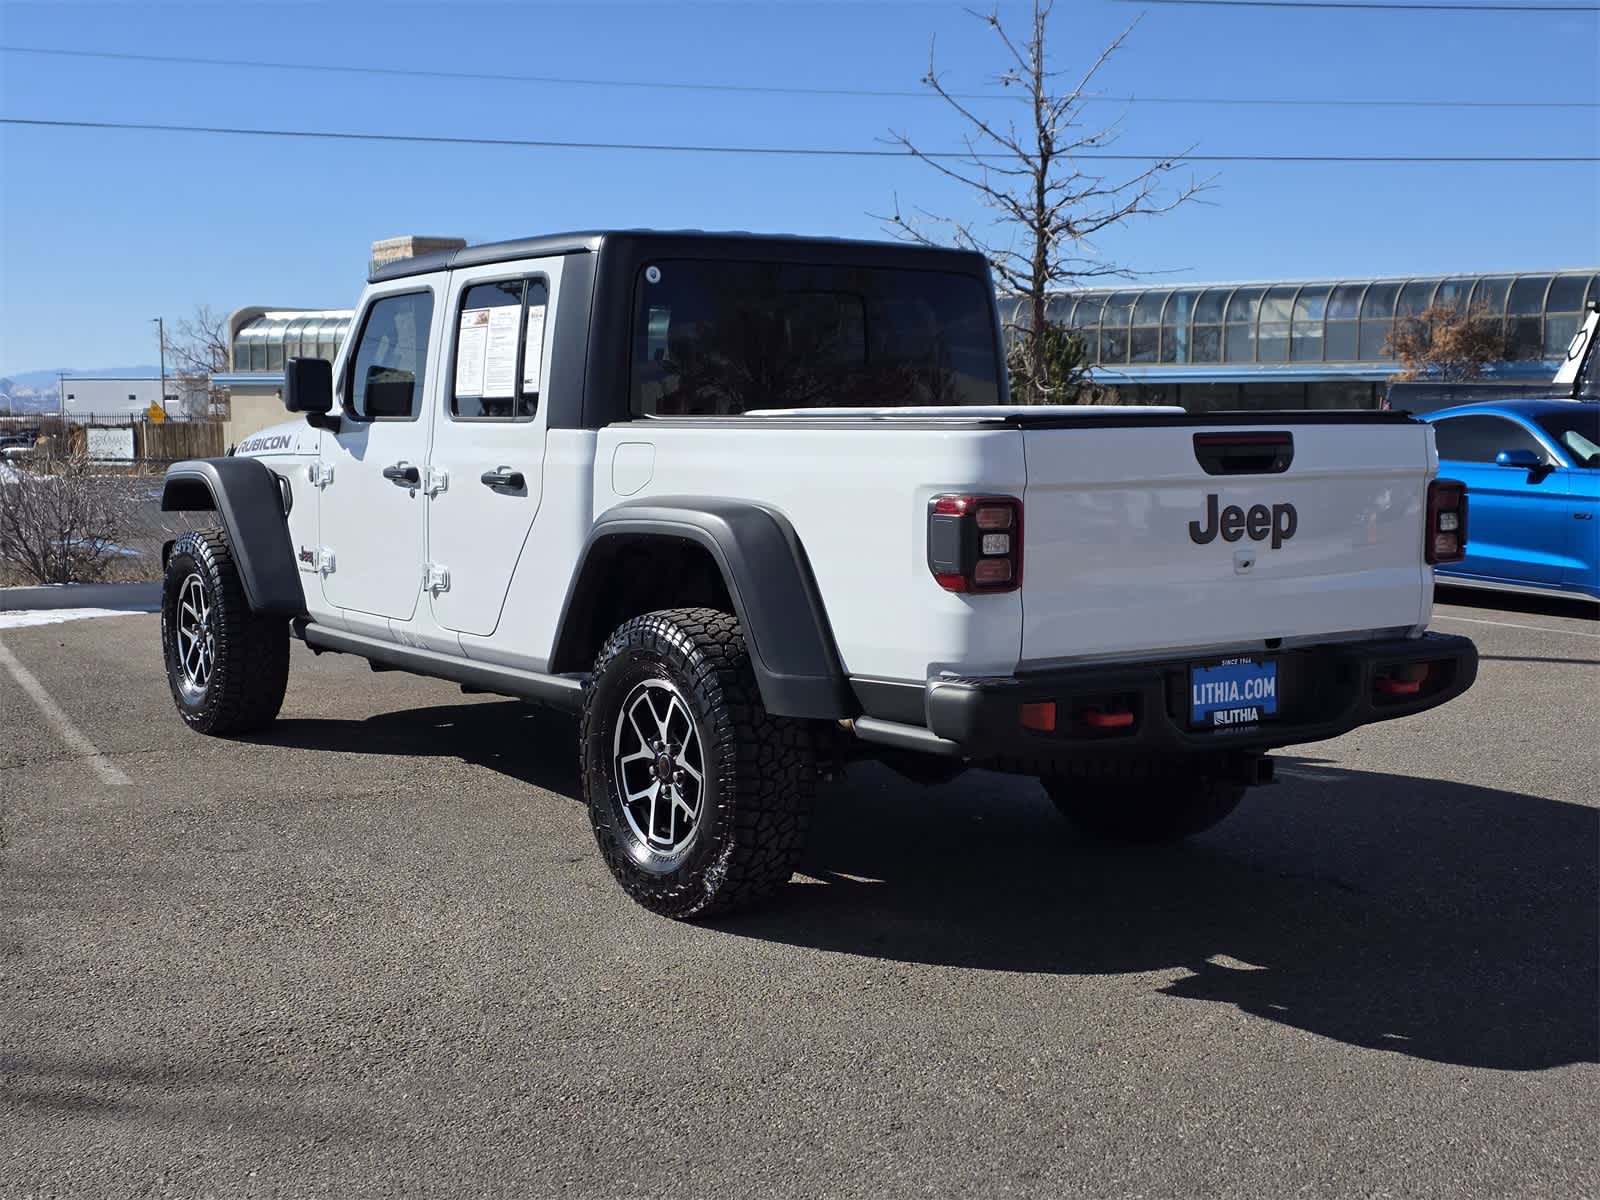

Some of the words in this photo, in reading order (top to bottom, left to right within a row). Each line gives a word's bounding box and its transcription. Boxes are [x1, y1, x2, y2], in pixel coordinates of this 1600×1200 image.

[238, 435, 292, 454] RUBICON
[1189, 494, 1298, 549] Jeep
[1193, 677, 1276, 705] LITHIA.COM
[1224, 707, 1259, 724] LITHIA
